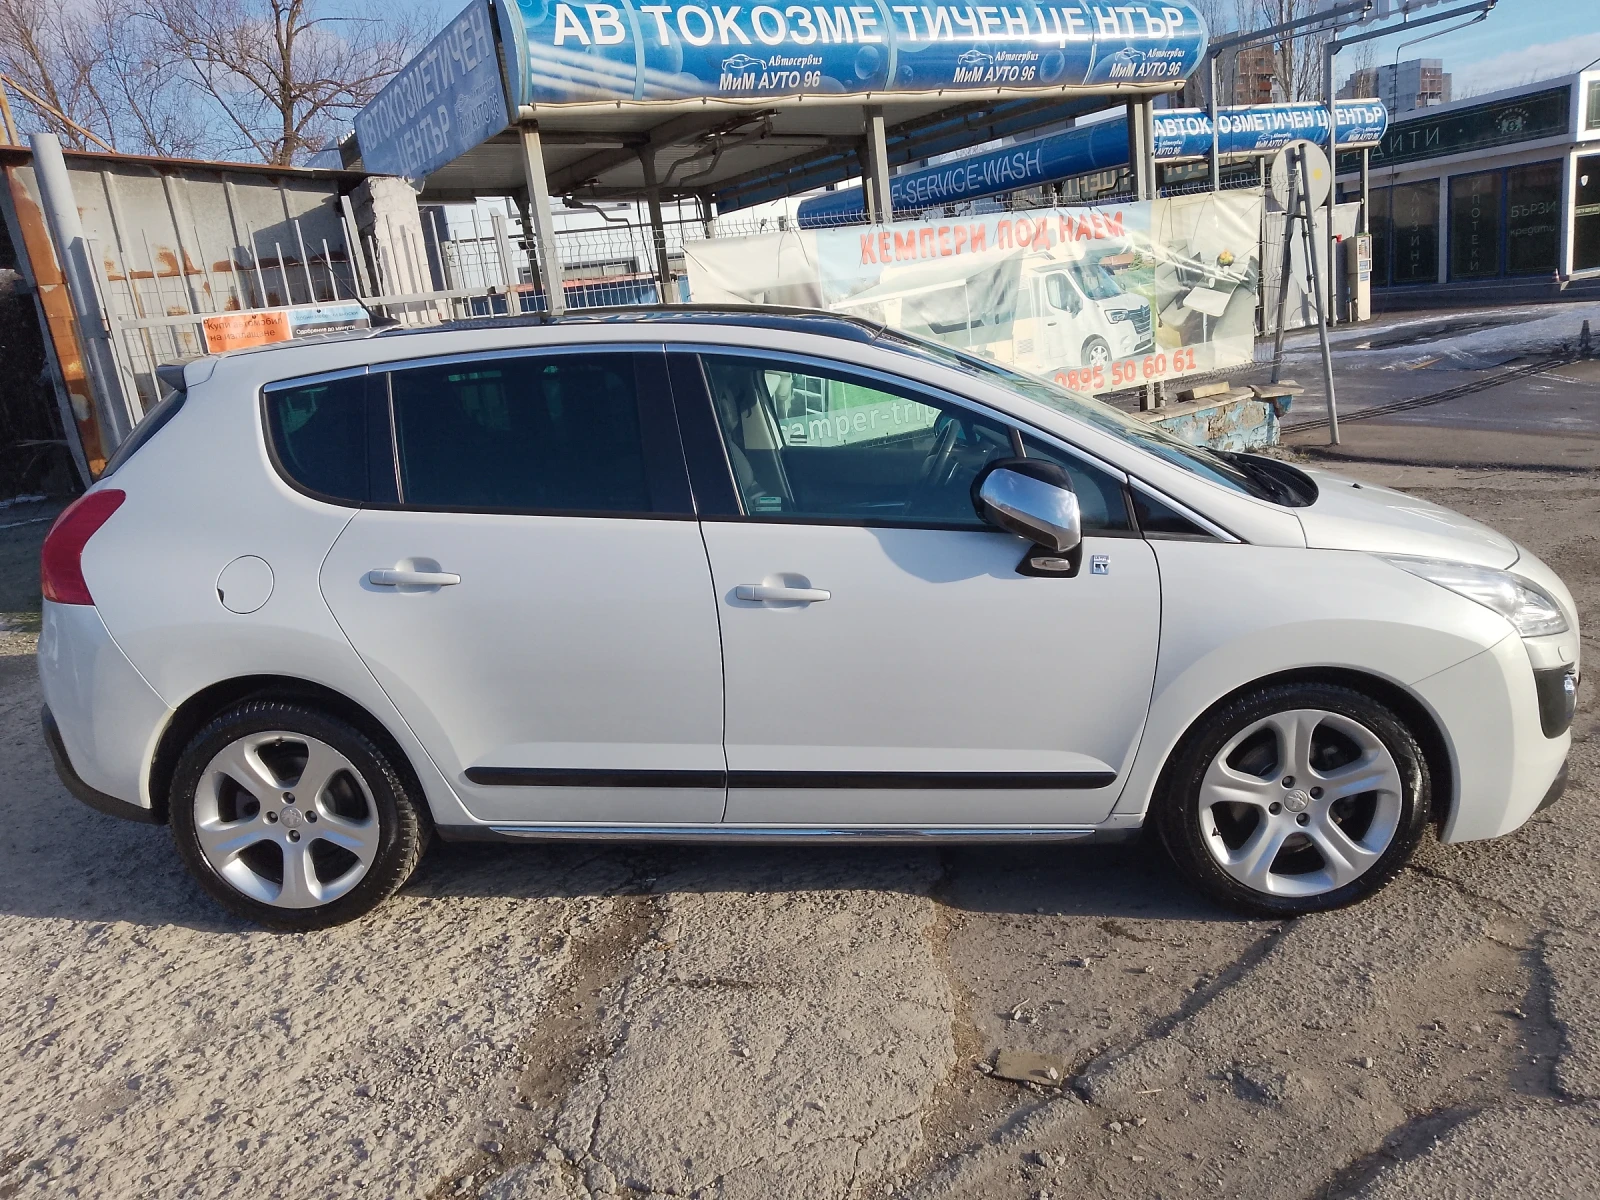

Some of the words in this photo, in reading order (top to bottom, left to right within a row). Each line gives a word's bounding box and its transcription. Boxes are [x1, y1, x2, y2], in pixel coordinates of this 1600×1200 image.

[1038, 7, 1184, 48] ЦЕНТЪР
[767, 54, 823, 69] Автосервиз
[994, 50, 1039, 65] Автосервиз
[1147, 47, 1185, 60] Автосервиз
[953, 66, 984, 83] МиМ
[984, 66, 1020, 82] АУТО
[1020, 65, 1036, 81] 96
[1109, 62, 1135, 77] МиМ
[1135, 61, 1166, 77] АУТО
[1167, 61, 1182, 76] 96
[360, 6, 490, 154] АВТОКОЗМЕТИЧЕН
[719, 73, 755, 91] МиМ
[758, 72, 800, 90] АУТО
[802, 70, 821, 88] 96
[396, 104, 451, 179] ЦЕНТЪР
[1511, 201, 1556, 218] БЪРЗИ
[860, 223, 987, 264] КЕМПЕРИ
[998, 217, 1050, 252] ПОД
[1058, 211, 1126, 243] НАЕМ
[207, 321, 231, 332] Купи
[233, 317, 283, 328] автомобил
[210, 334, 222, 342] на
[1054, 365, 1105, 392] 0895
[1111, 359, 1137, 386] 50
[1142, 353, 1167, 379] 60
[1172, 347, 1197, 373] 61
